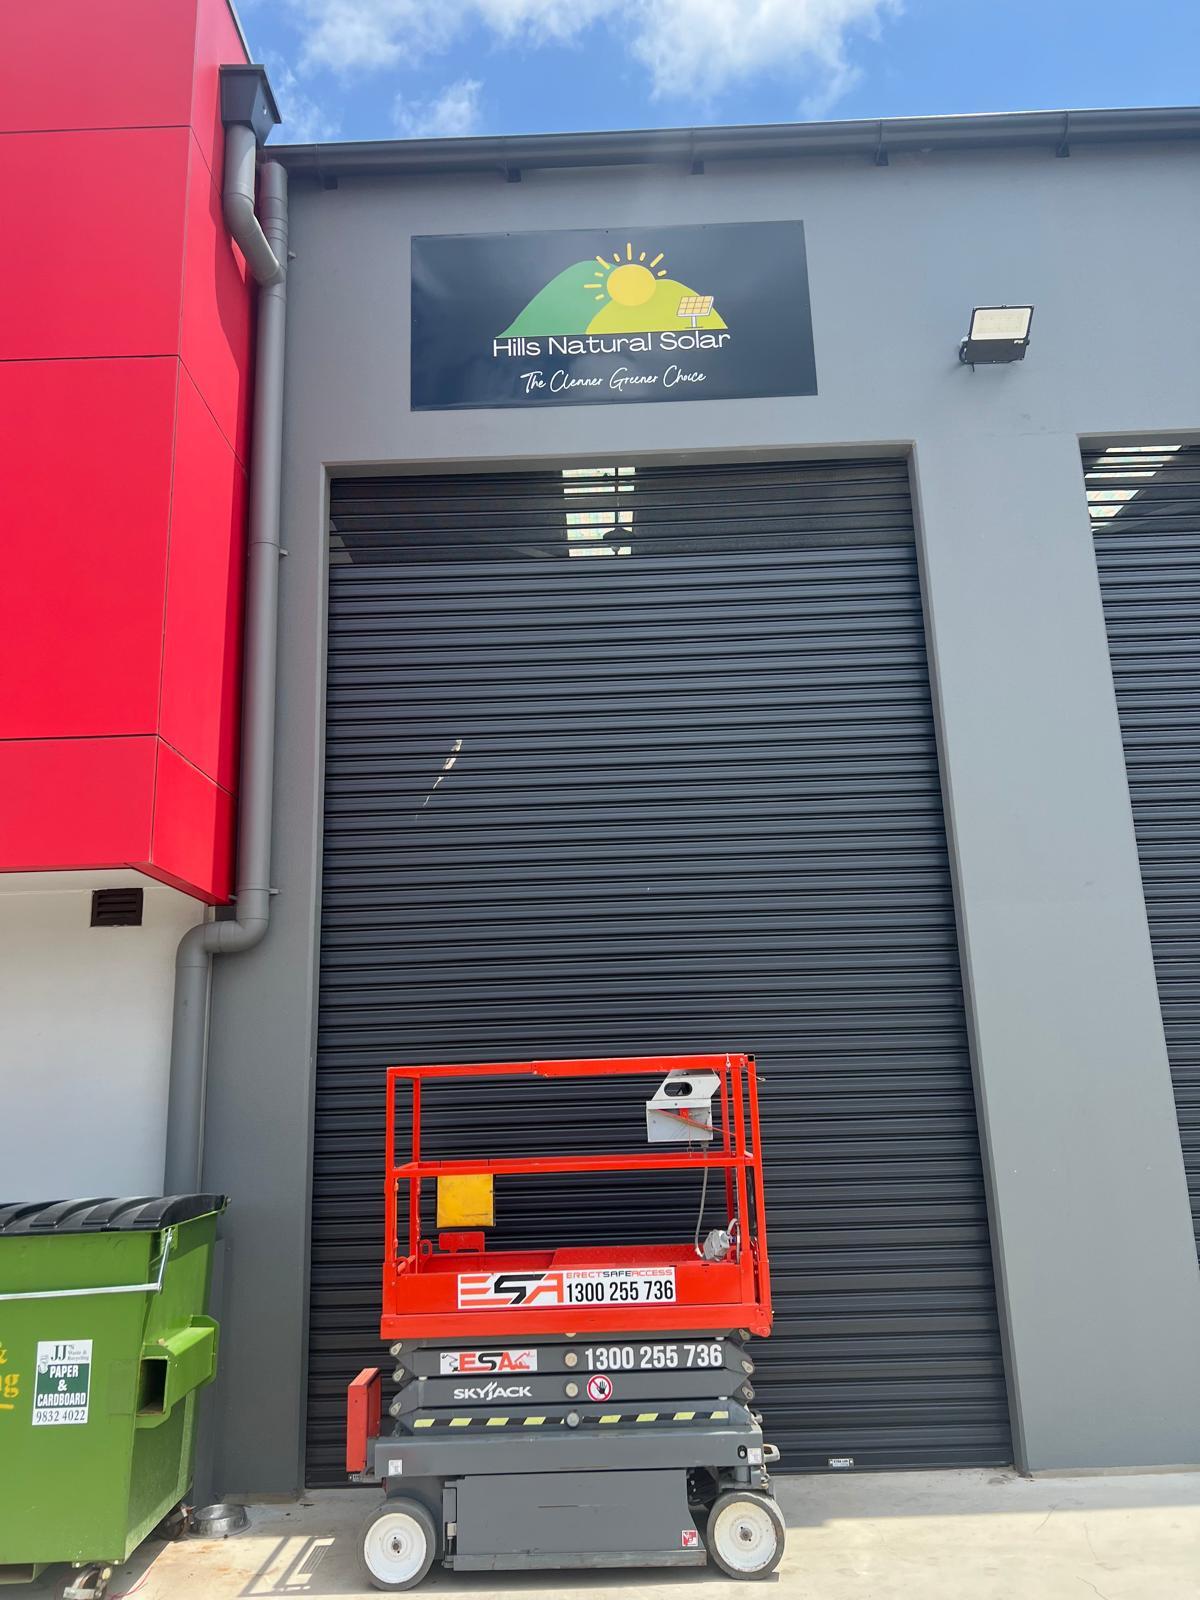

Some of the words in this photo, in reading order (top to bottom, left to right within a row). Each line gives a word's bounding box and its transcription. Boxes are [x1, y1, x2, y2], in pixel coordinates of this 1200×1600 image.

[492, 337, 541, 357] Hills
[548, 333, 652, 356] Natural
[659, 330, 731, 350] Solar
[520, 370, 547, 394] The
[609, 367, 659, 392] Greener
[663, 364, 707, 388] Choice
[460, 1273, 565, 1307] ESA
[566, 1282, 605, 1303] 1300
[609, 1281, 640, 1302] 255
[643, 1280, 674, 1300] 736
[458, 1352, 511, 1371] ESA
[585, 1347, 634, 1370] 1300
[640, 1346, 679, 1368] 255
[684, 1344, 723, 1367] 736
[49, 1365, 79, 1379] PAPER
[57, 1379, 68, 1392] &
[453, 1382, 532, 1400] SKYJACK
[36, 1392, 87, 1407] CARDBOARD
[36, 1410, 60, 1423] 9832
[62, 1409, 86, 1421] 4022
